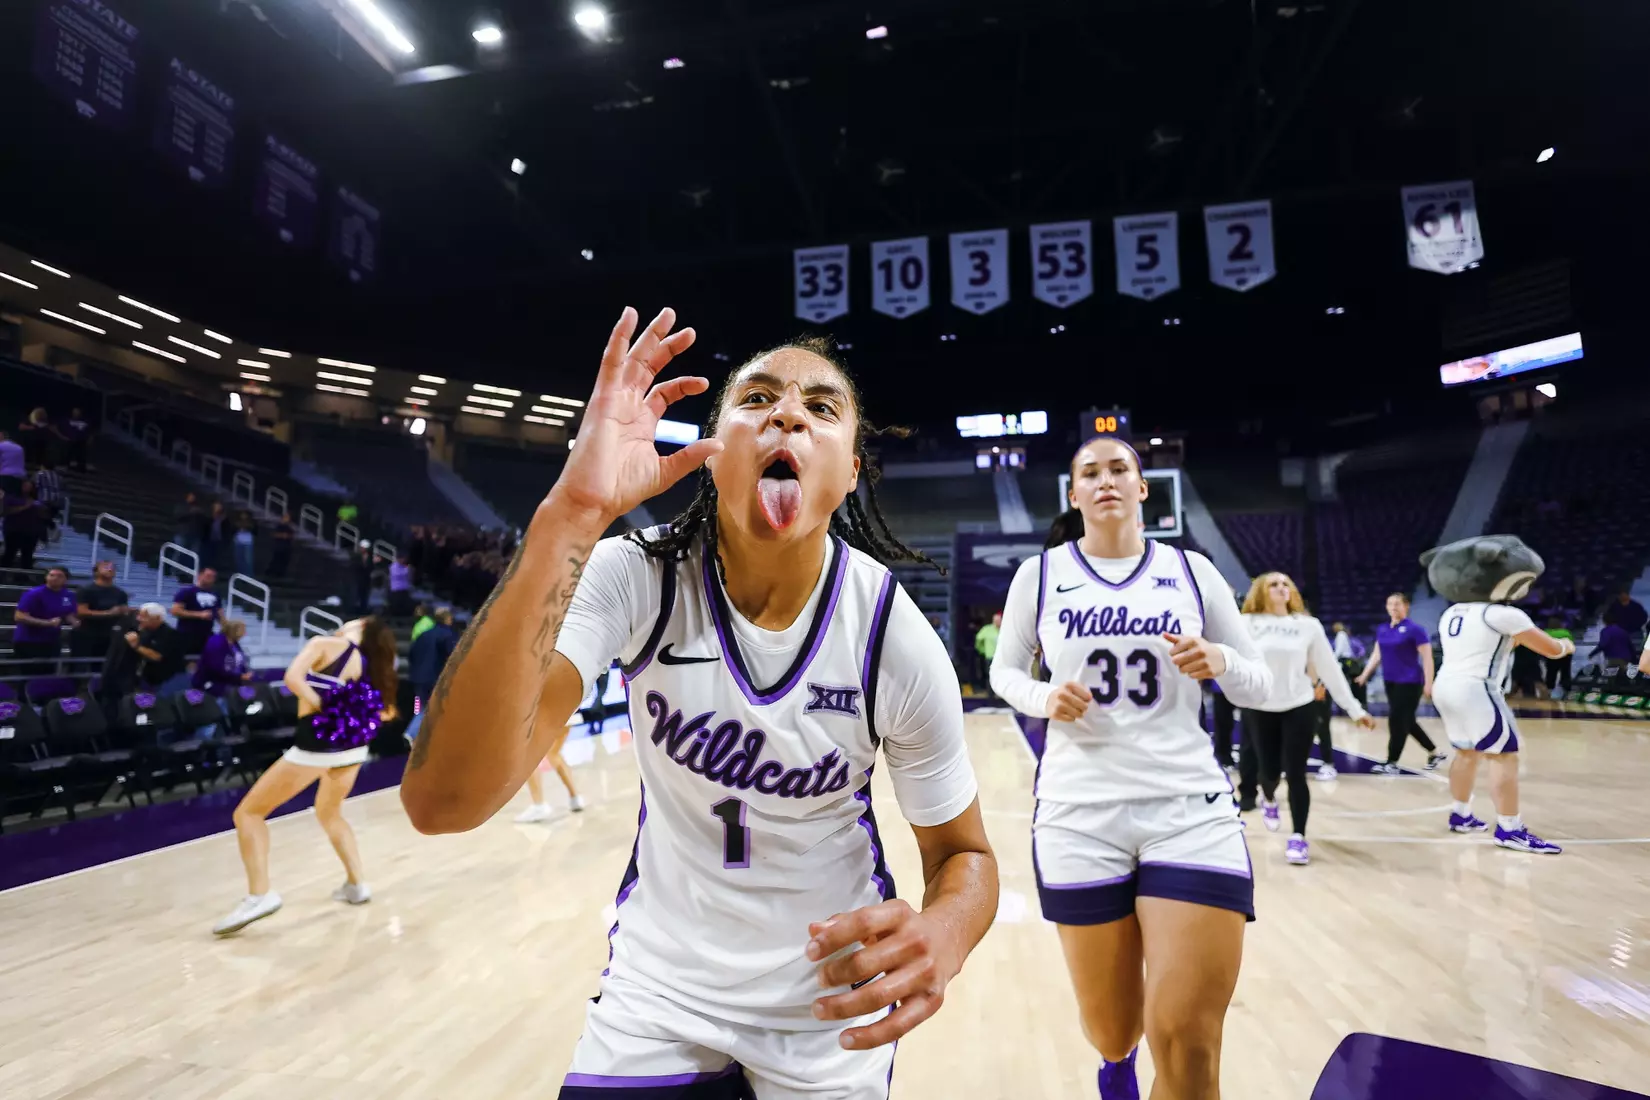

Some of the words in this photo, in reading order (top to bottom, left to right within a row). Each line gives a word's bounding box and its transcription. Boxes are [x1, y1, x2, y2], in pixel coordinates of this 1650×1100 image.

[1414, 200, 1464, 238] 61
[1038, 241, 1086, 280] 53
[1135, 233, 1160, 271] 5
[1226, 223, 1254, 262] 2
[799, 263, 843, 298] 33
[877, 256, 923, 293] 10
[968, 251, 991, 286] 3
[1059, 605, 1182, 640] Wildcats
[1448, 615, 1463, 638] 0
[1087, 648, 1162, 708] 33
[806, 684, 859, 716] XII
[646, 689, 851, 799] Wildcats
[711, 796, 751, 869] 1
